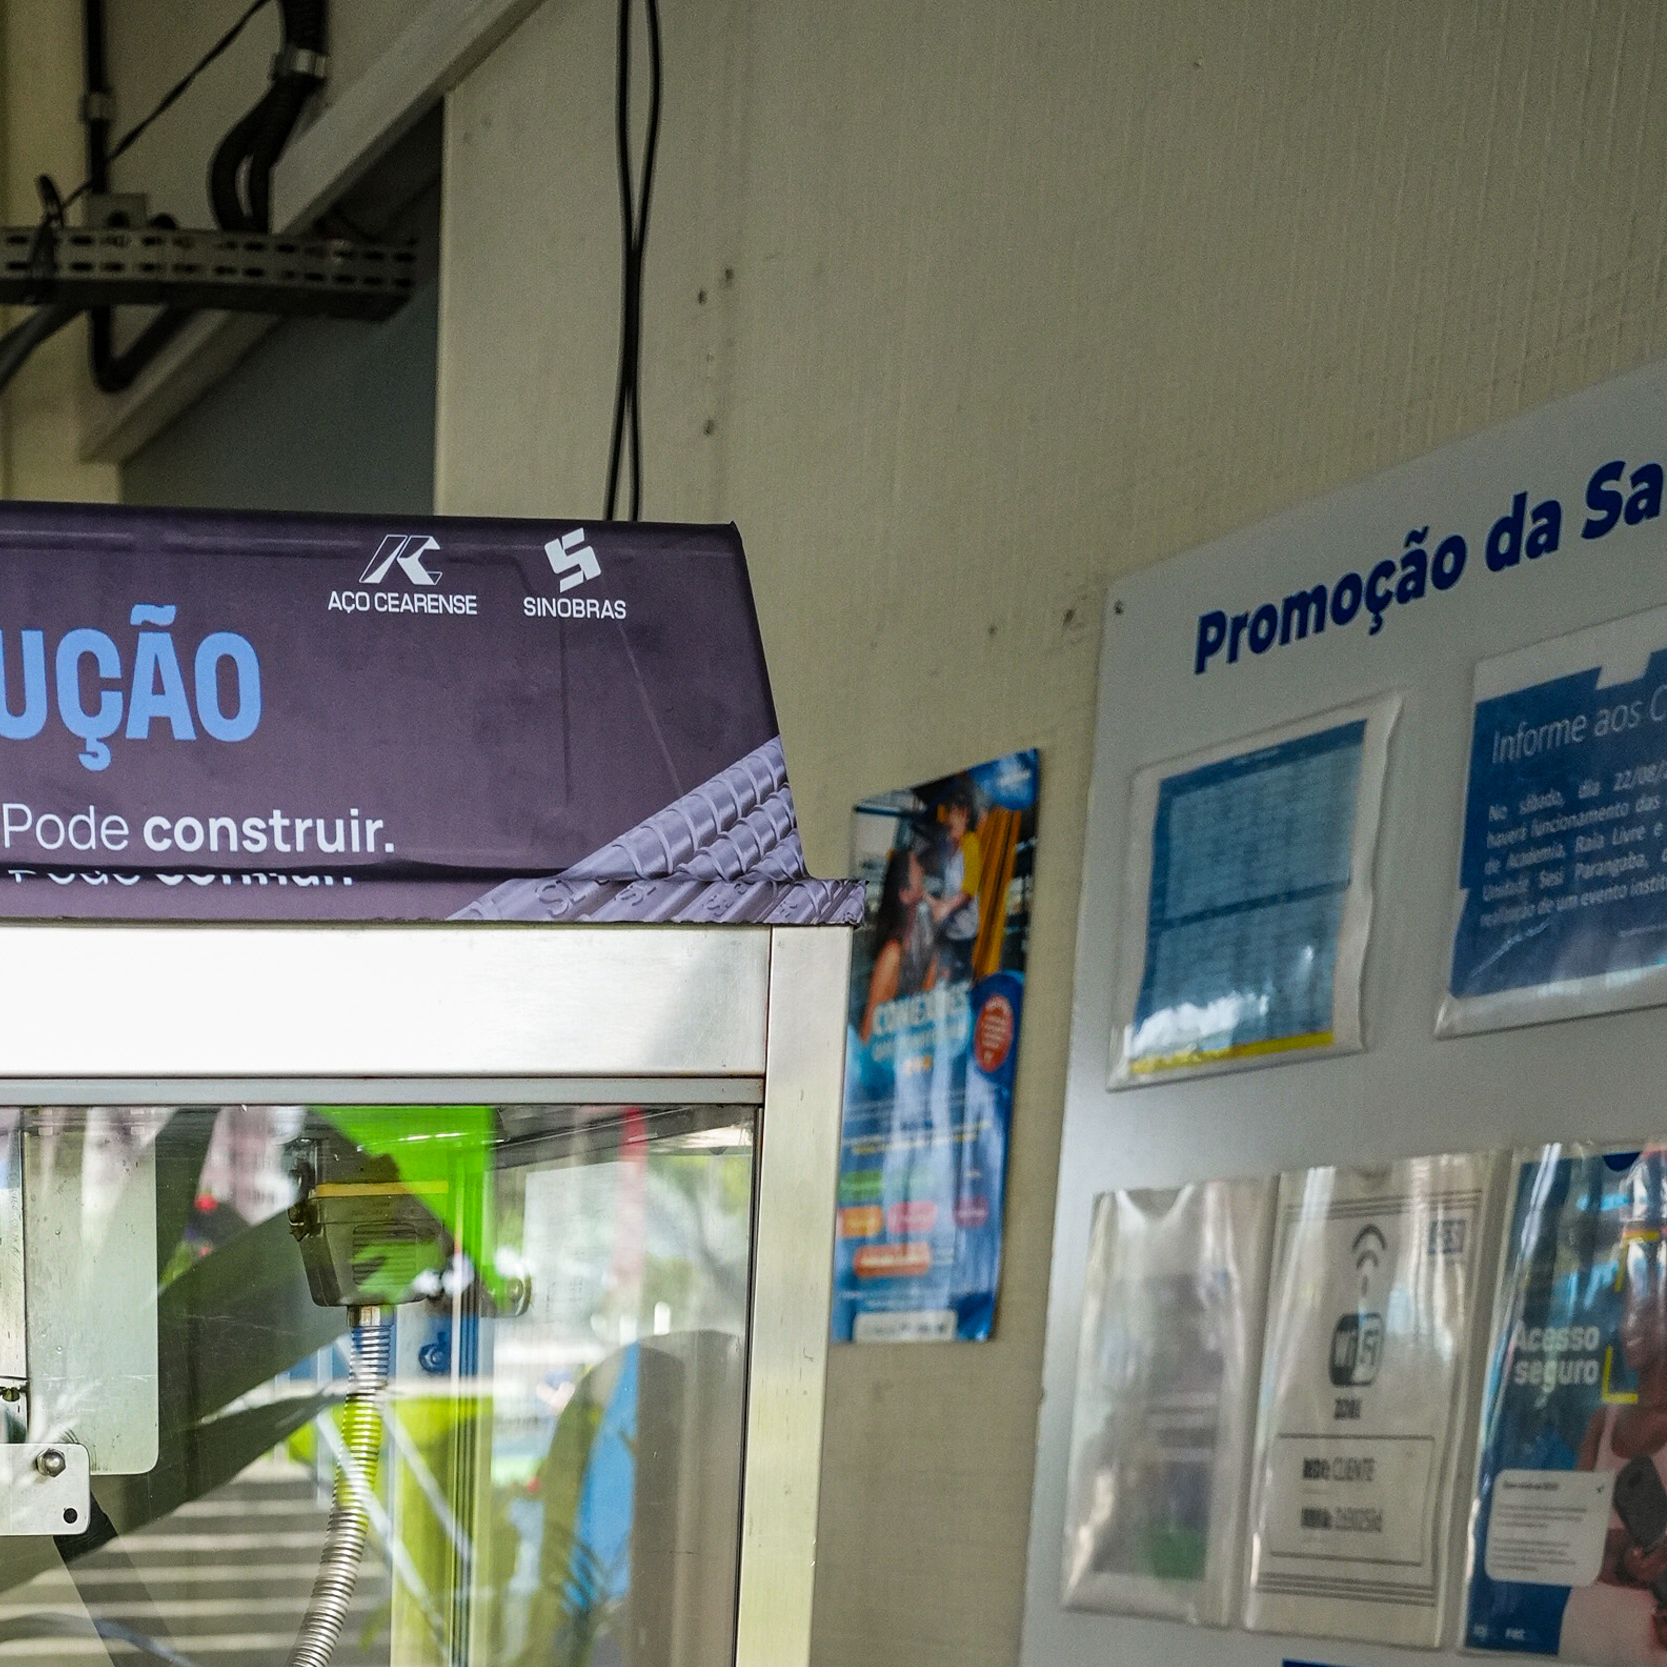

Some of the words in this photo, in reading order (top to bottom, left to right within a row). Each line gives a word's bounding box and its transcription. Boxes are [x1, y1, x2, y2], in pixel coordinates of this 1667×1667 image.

[1195, 525, 1467, 675] Promoção
[1485, 491, 1562, 572] da
[328, 591, 371, 615] AÇO
[375, 593, 479, 615] CEARENSE
[524, 597, 628, 620] SINOBRAS
[1492, 713, 1587, 764] Informe
[1594, 700, 1643, 738] aos
[2, 803, 130, 851] Pode
[144, 808, 396, 853] construir.
[1513, 1319, 1600, 1351] Acesso
[1514, 1359, 1600, 1393] seguro
